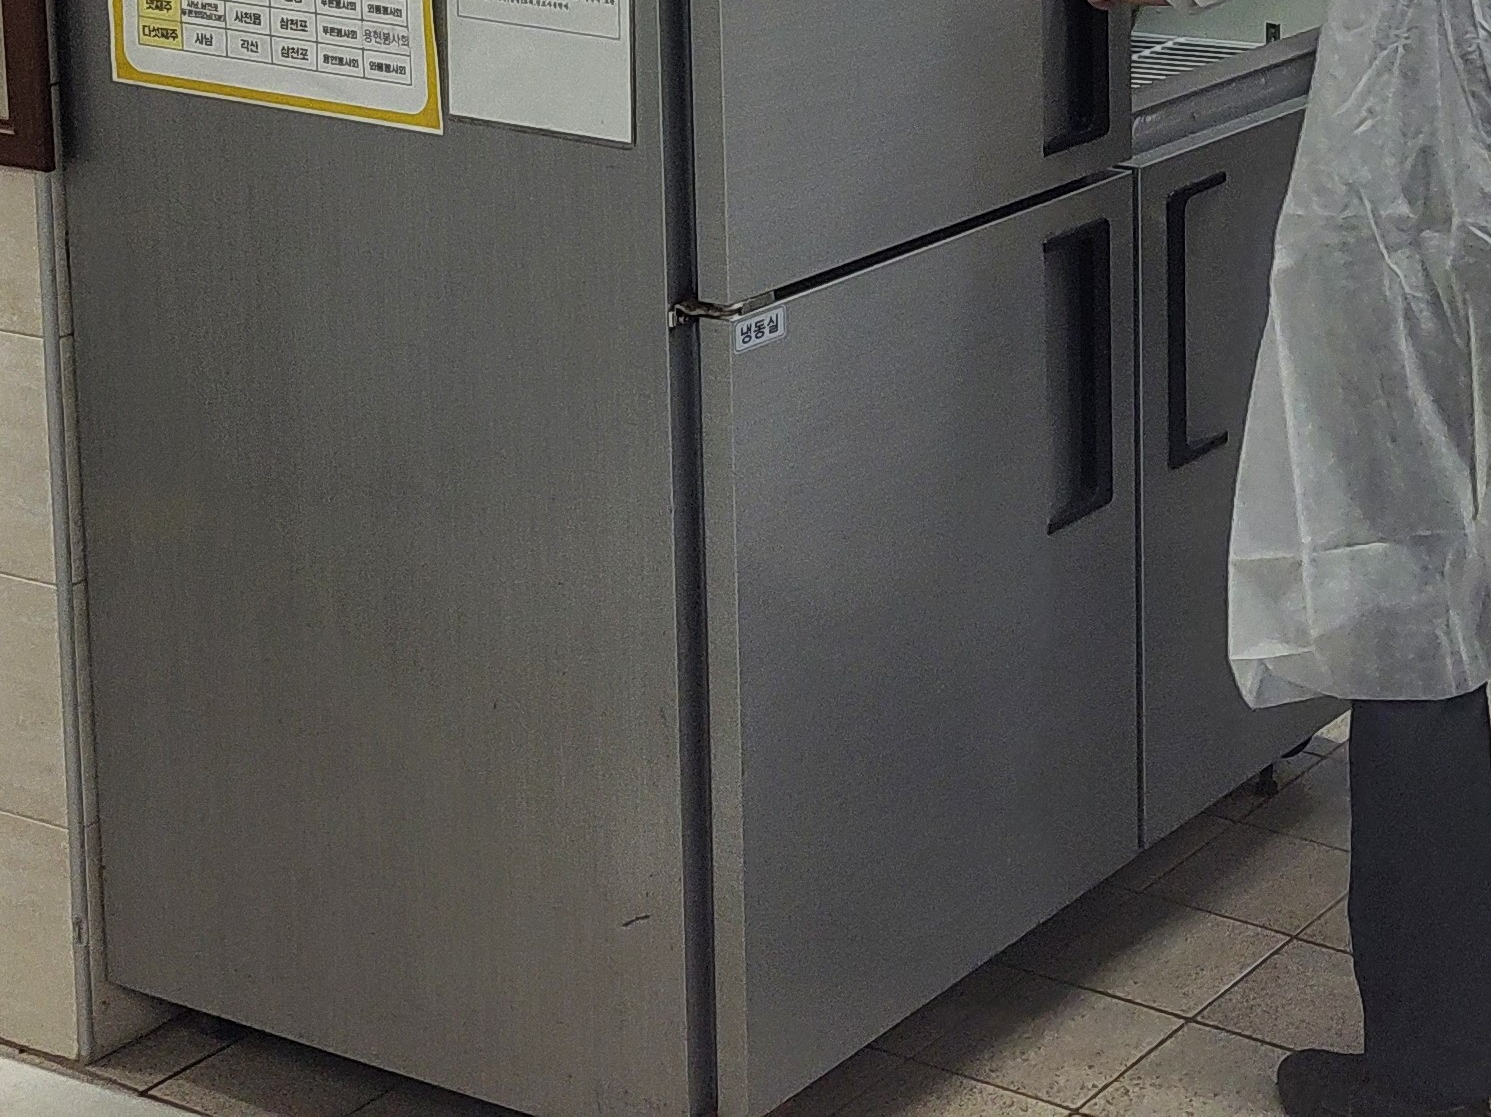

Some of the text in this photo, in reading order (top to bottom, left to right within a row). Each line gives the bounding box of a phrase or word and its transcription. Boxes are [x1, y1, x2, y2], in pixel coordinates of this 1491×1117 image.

[234, 10, 261, 26] 사천읍
[280, 16, 308, 32] 삼천포
[142, 25, 178, 41] 다섯째주
[195, 32, 213, 47] 사남
[364, 29, 409, 48] 용현봉사회
[281, 45, 309, 61] 삼천포
[740, 313, 778, 344] 냉동실
